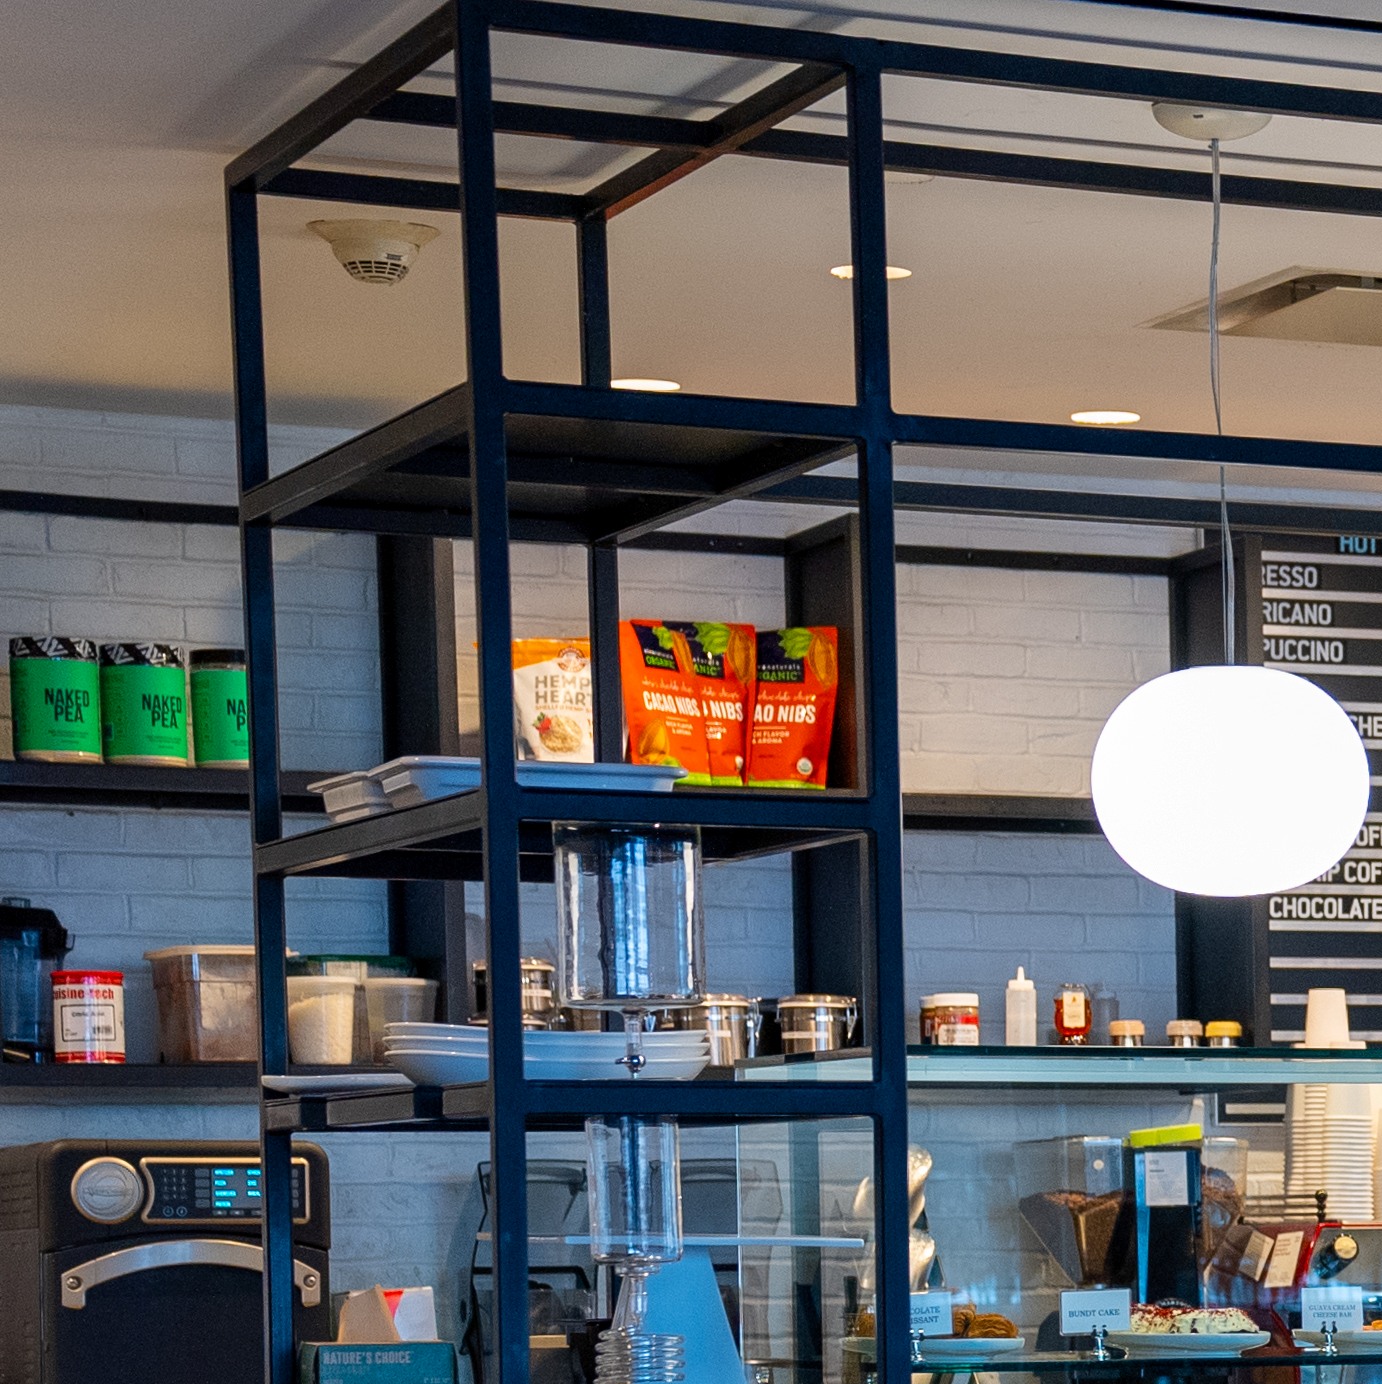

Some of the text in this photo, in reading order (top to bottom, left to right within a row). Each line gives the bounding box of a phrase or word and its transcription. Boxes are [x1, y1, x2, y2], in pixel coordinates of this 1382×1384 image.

[1262, 565, 1318, 588] ESSO
[1263, 602, 1332, 625] RICANO
[1264, 639, 1344, 663] PUCCINO
[534, 675, 591, 690] HEMP
[44, 687, 90, 708] NAKED
[141, 693, 182, 714] NAKED
[643, 690, 700, 717] CACAO NIBS
[54, 704, 84, 724] PEA
[151, 710, 179, 729] PEA
[710, 700, 743, 722] NIBS
[777, 704, 816, 724] NIBS
[1068, 1308, 1120, 1318] BUNDT CAKE
[1313, 1311, 1337, 1319] CHEESE
[323, 1350, 412, 1365] NATURE'S CHOICE
